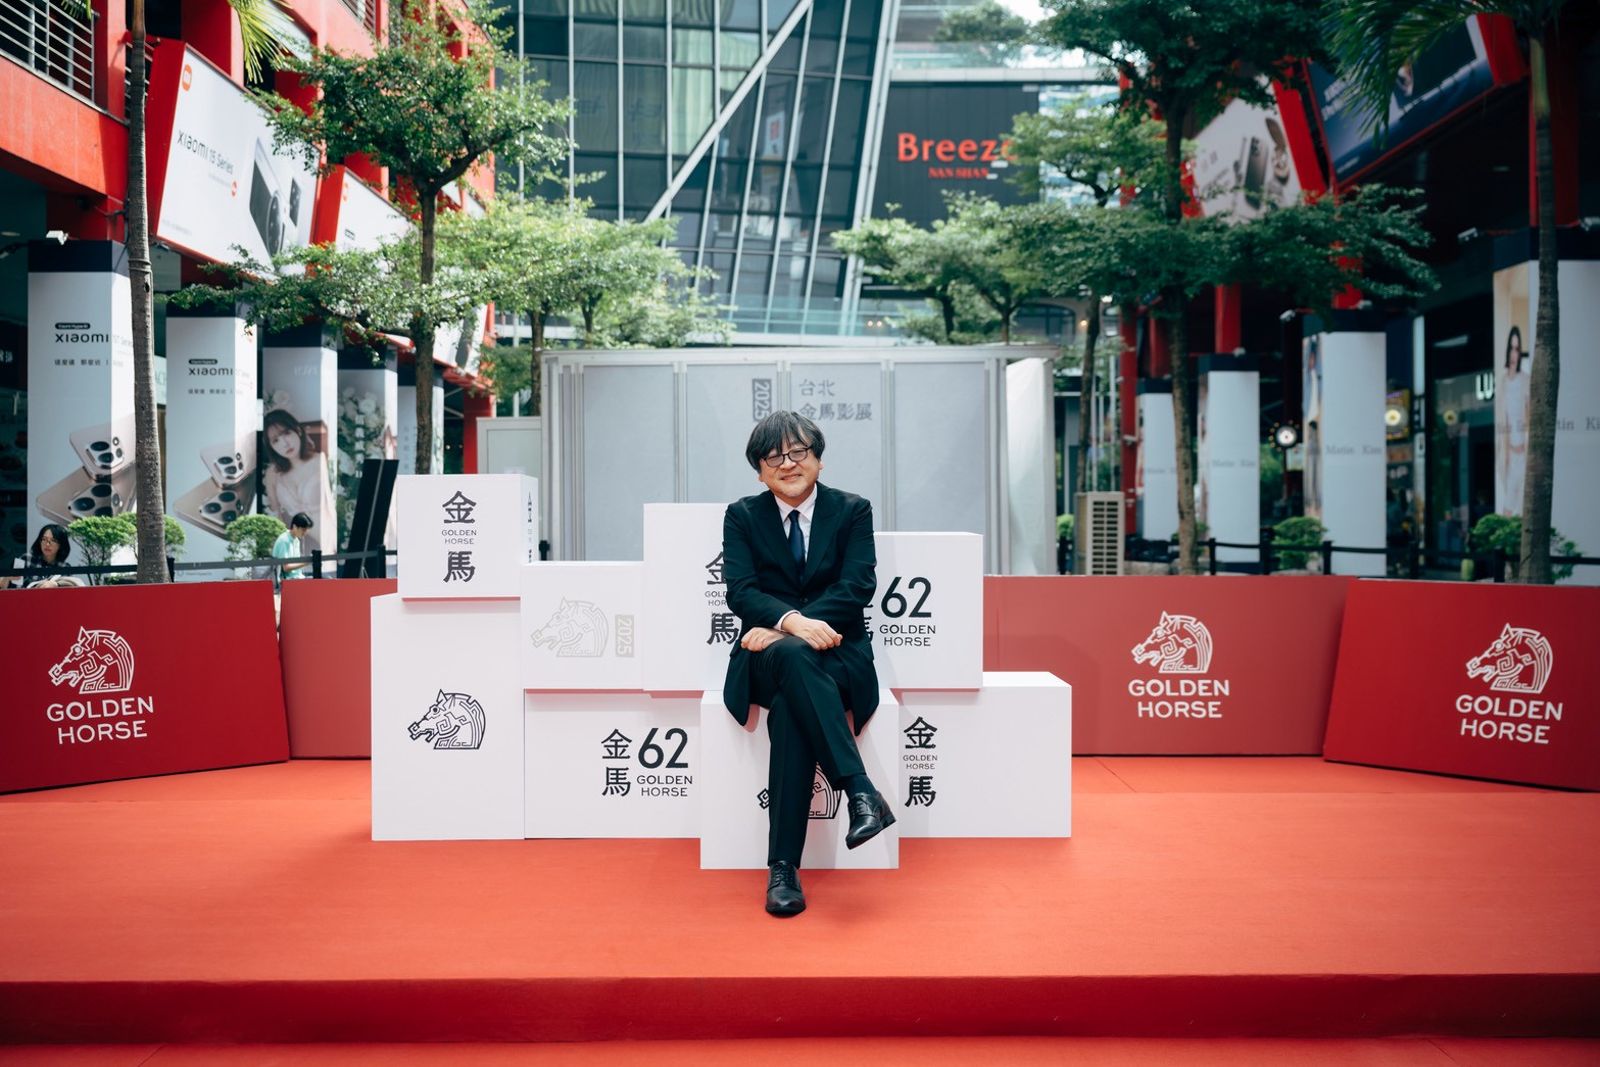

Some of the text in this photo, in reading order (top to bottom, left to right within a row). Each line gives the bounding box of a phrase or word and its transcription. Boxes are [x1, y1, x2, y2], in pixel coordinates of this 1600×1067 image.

[177, 130, 209, 161] xiaomi
[55, 333, 109, 343] xiaomi
[188, 367, 234, 376] xiaomi
[799, 379, 835, 396] 台北
[754, 381, 770, 420] 2025
[800, 402, 872, 421] 金馬影展
[1585, 416, 1600, 430] Ki
[442, 490, 477, 524] 金
[443, 550, 476, 583] 馬
[705, 590, 727, 598] GOLD
[708, 599, 727, 607] HOR
[881, 576, 932, 618] 62
[616, 616, 633, 656] 2025
[706, 612, 739, 645] 馬
[879, 624, 936, 635] GOLDEN
[883, 636, 932, 647] HORSE
[1128, 679, 1230, 697] GOLDEN
[46, 695, 154, 722] GOLDEN
[1137, 701, 1223, 719] HORSE
[1455, 694, 1564, 721] GOLDEN
[57, 720, 148, 745] HORSE
[903, 716, 938, 749] 金
[1460, 718, 1551, 745] HORSE
[637, 727, 690, 769] 62
[902, 754, 938, 762] GOLDEN
[601, 728, 633, 797] 金馬
[636, 774, 694, 785] GOLDEN
[641, 787, 690, 797] HORSE
[904, 775, 936, 807] 馬
